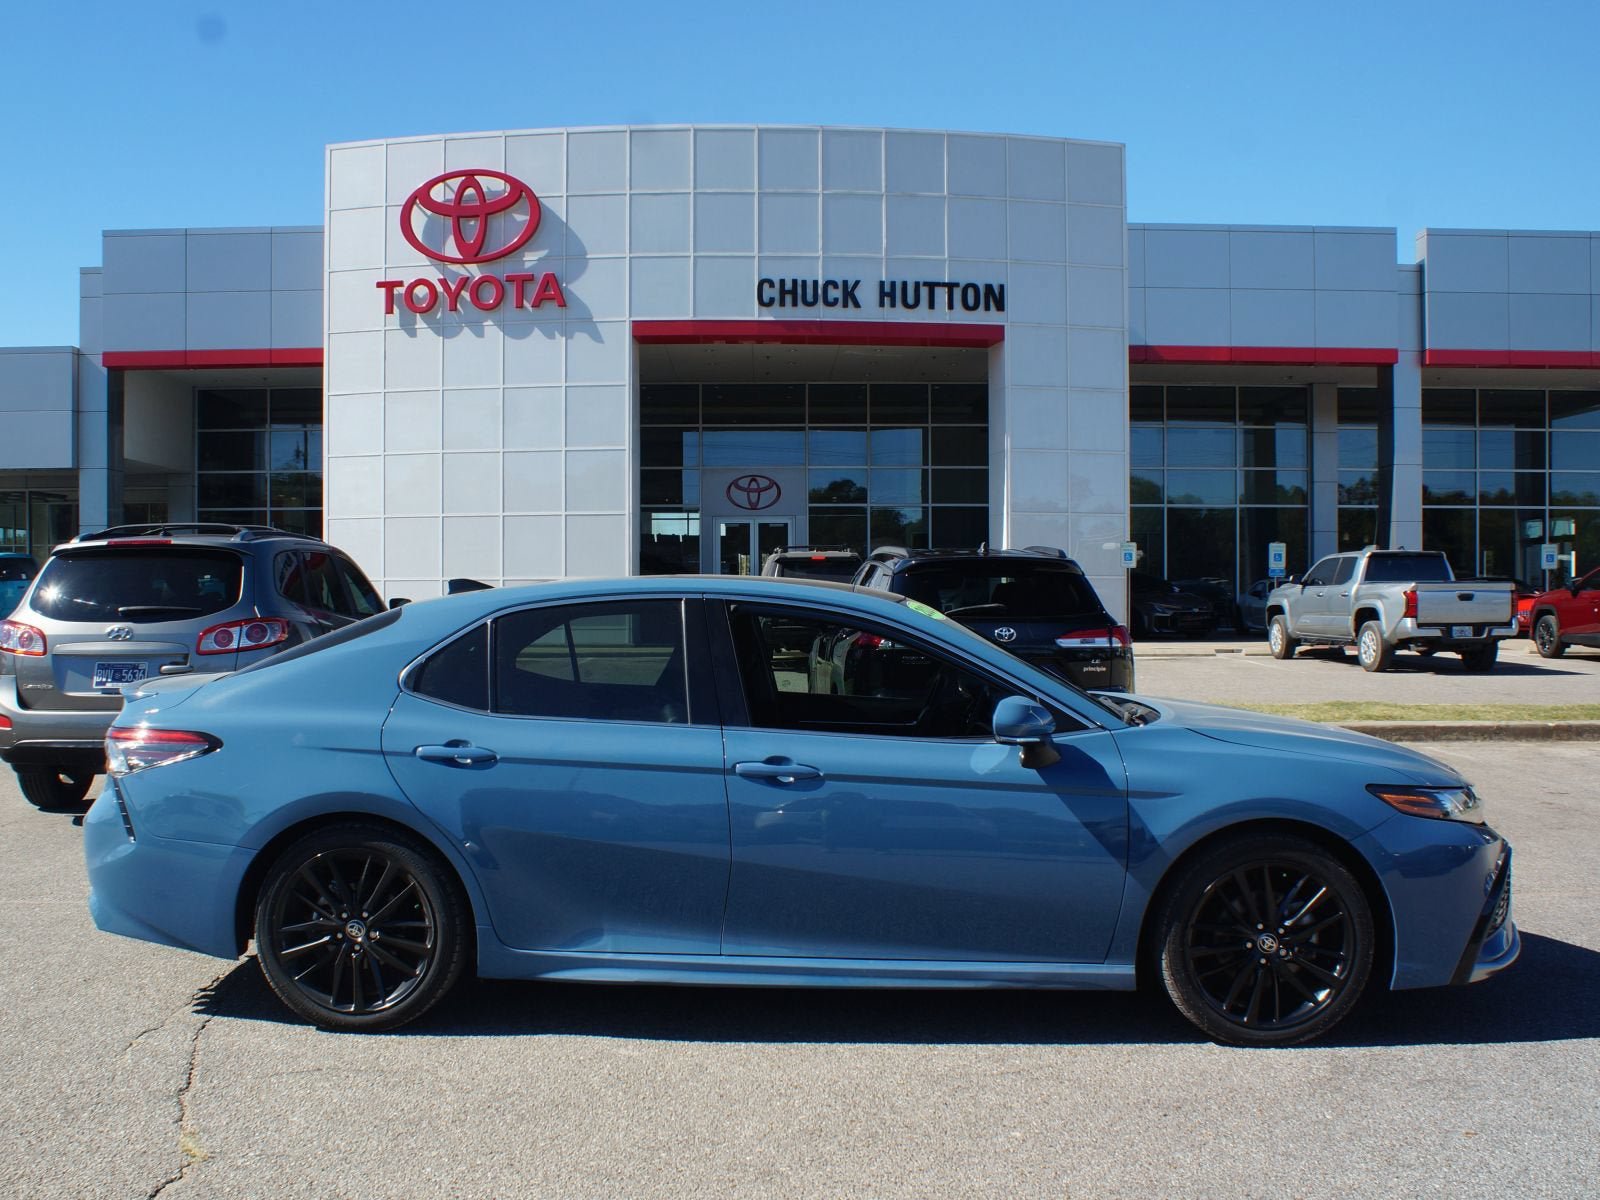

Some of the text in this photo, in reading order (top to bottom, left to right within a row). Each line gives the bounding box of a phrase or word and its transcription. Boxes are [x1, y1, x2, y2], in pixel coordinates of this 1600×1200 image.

[376, 272, 567, 314] TOYOTA
[757, 278, 1006, 312] CHUCK HUTTON
[121, 669, 145, 681] 5636
